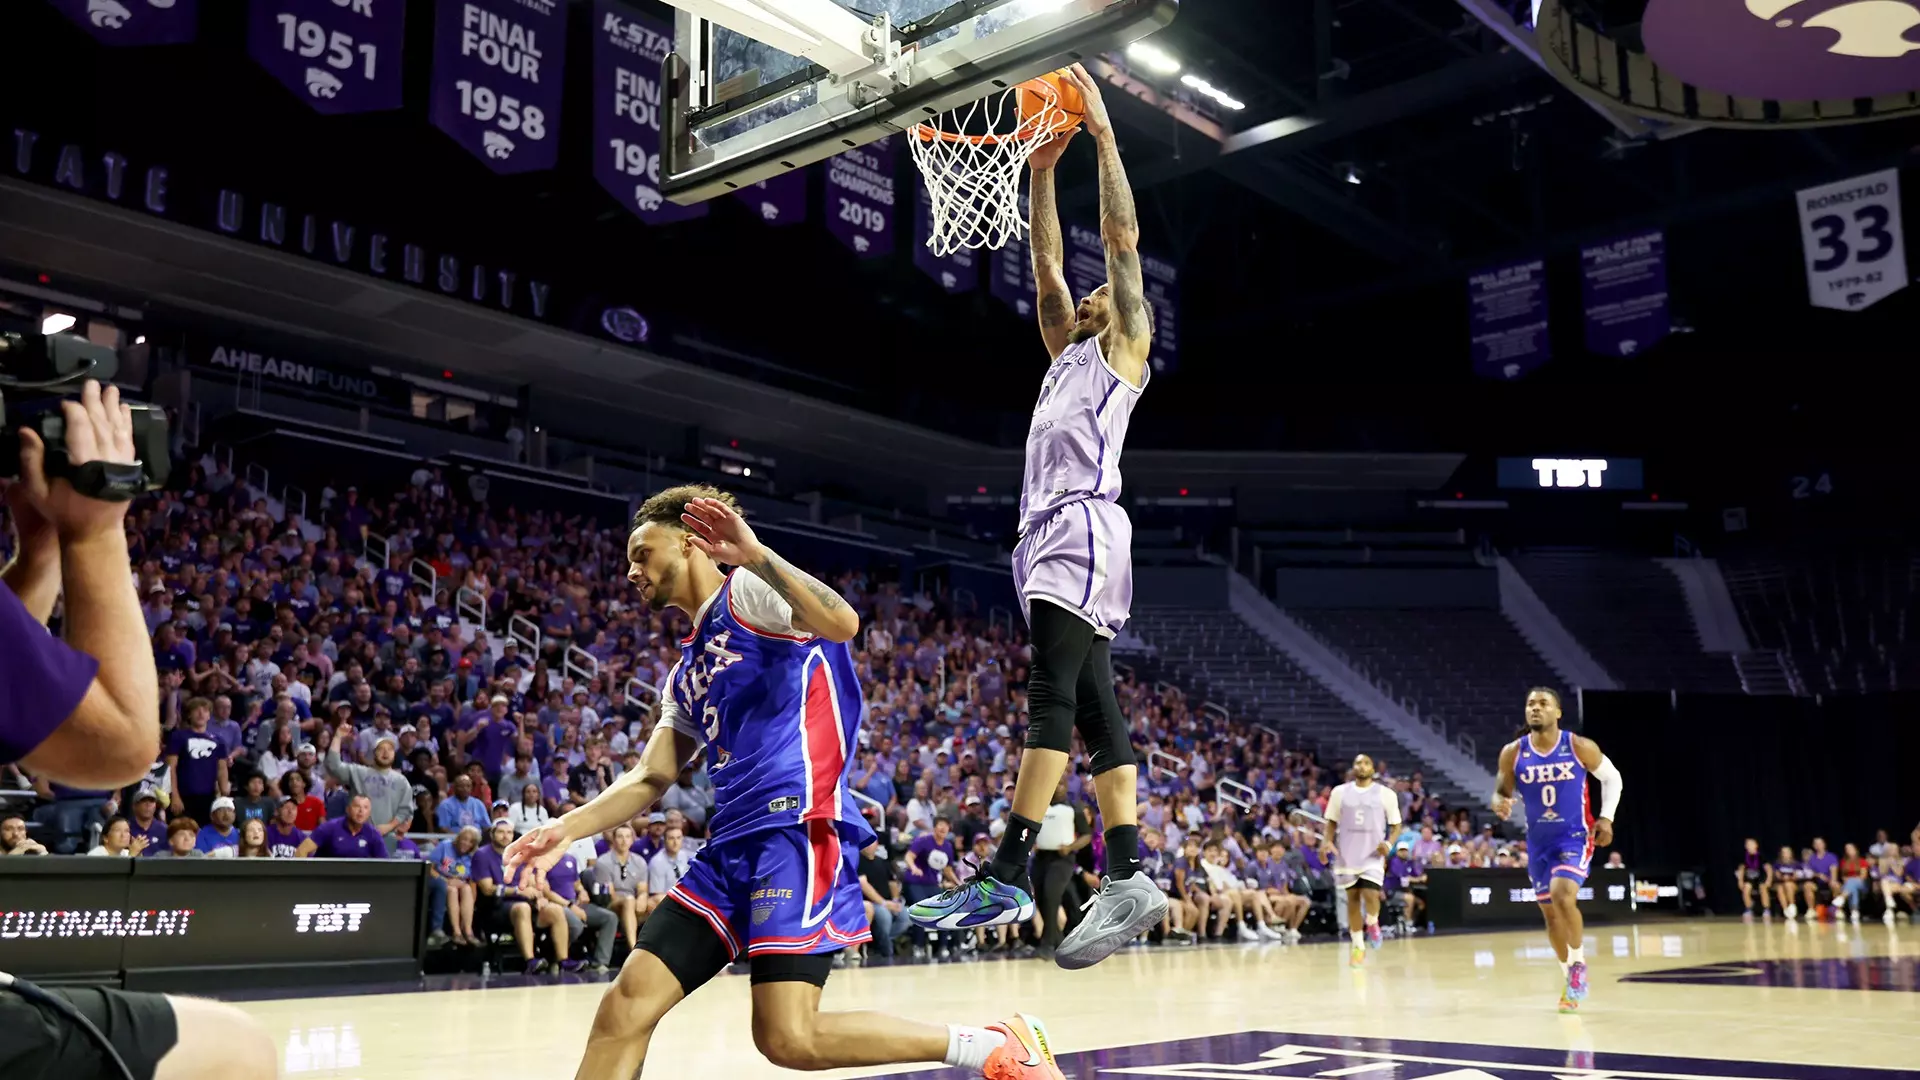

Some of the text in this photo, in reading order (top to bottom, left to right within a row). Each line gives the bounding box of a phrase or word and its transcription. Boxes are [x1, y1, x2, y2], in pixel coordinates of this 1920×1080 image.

[276, 12, 378, 81] 1951
[463, 3, 543, 60] FINAL
[603, 12, 671, 53] K-STA
[460, 29, 540, 84] FOUR
[615, 66, 661, 106] FIN
[455, 79, 547, 141] 1958
[615, 92, 661, 131] FOU
[609, 138, 661, 185] 196
[864, 154, 879, 170] 12
[829, 167, 895, 206] CHAMPIONS
[1806, 182, 1888, 211] ROMSTAD
[14, 127, 552, 318] TATE UNIVERSITY
[838, 197, 886, 233] 2019
[1811, 204, 1893, 273] 33
[210, 345, 378, 398] AHEARNFUND
[1531, 458, 1608, 488] TBT
[1789, 472, 1834, 499] 24
[1520, 761, 1576, 784] JHX
[1541, 784, 1557, 807] 0
[766, 888, 793, 899] ELITE
[292, 903, 371, 933] TBT
